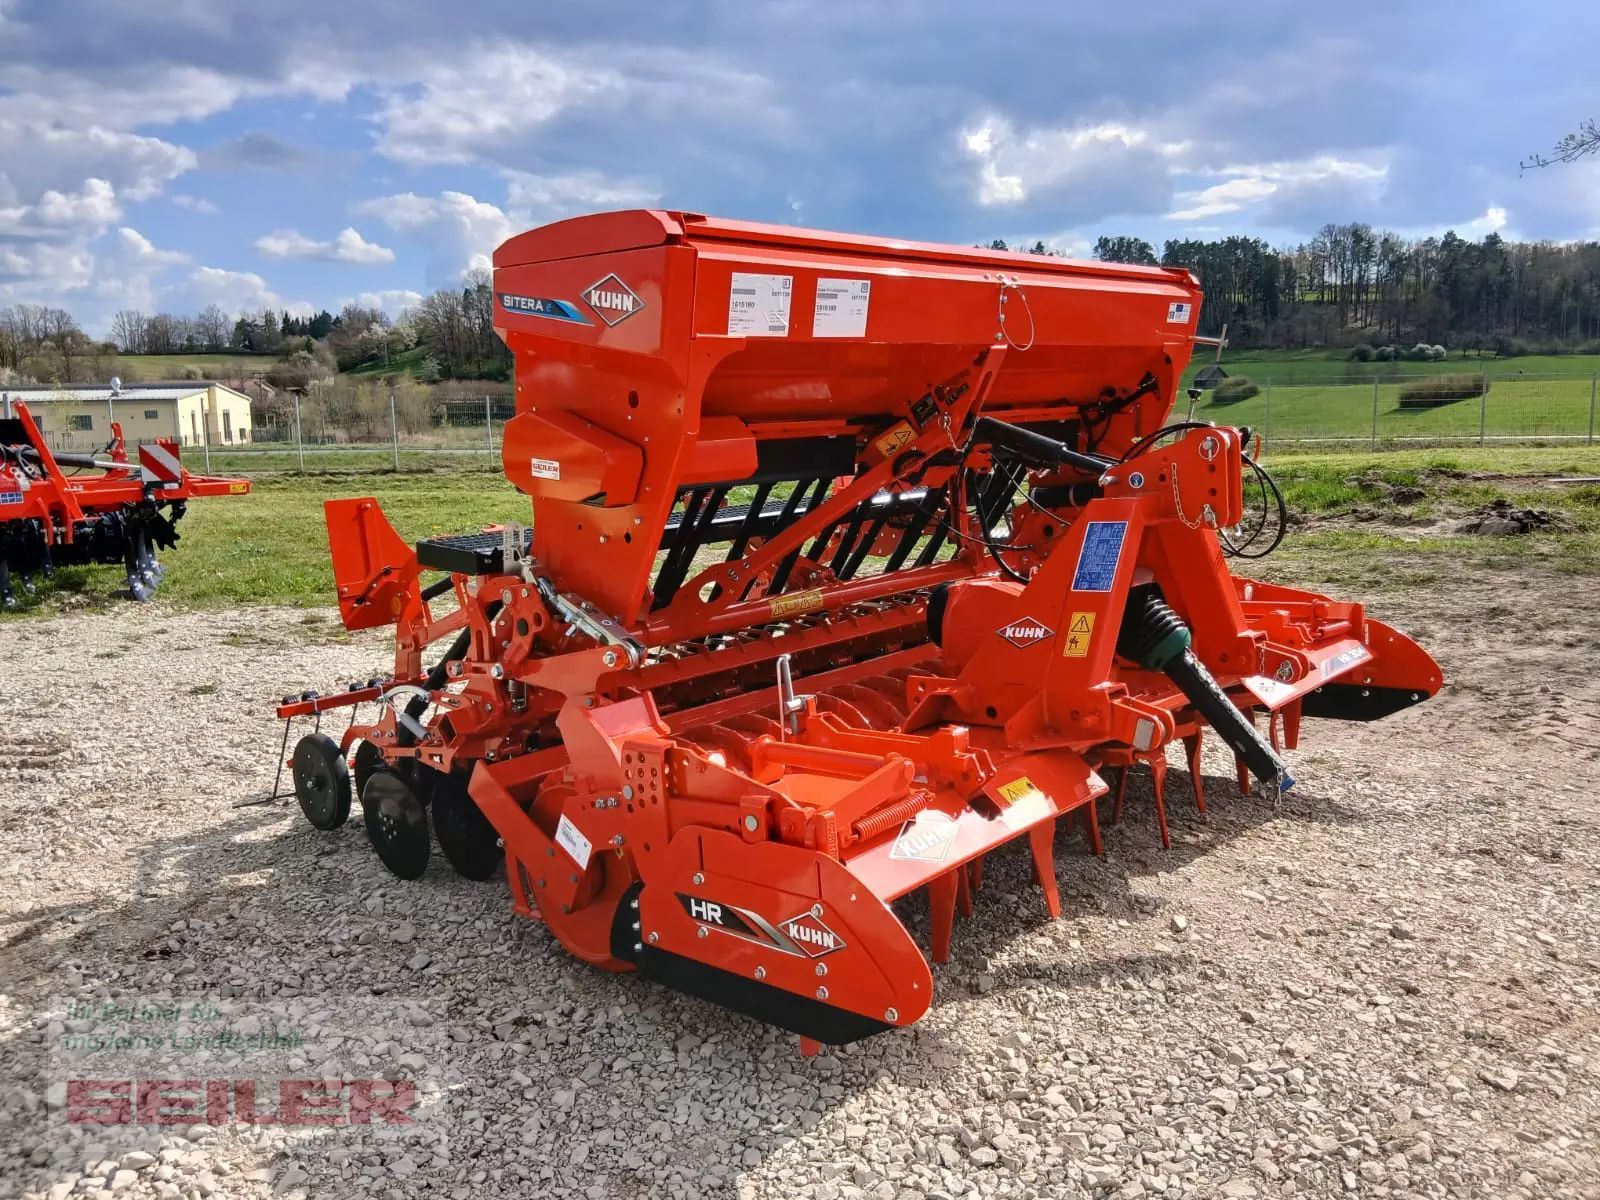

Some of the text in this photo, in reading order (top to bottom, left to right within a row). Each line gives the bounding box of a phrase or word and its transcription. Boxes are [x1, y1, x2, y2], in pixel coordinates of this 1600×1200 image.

[503, 294, 544, 313] SITERA
[590, 289, 634, 312] KUHN
[1005, 626, 1045, 639] KUHN
[898, 826, 951, 857] KUH
[690, 897, 724, 926] HR
[788, 922, 836, 949] KUHN
